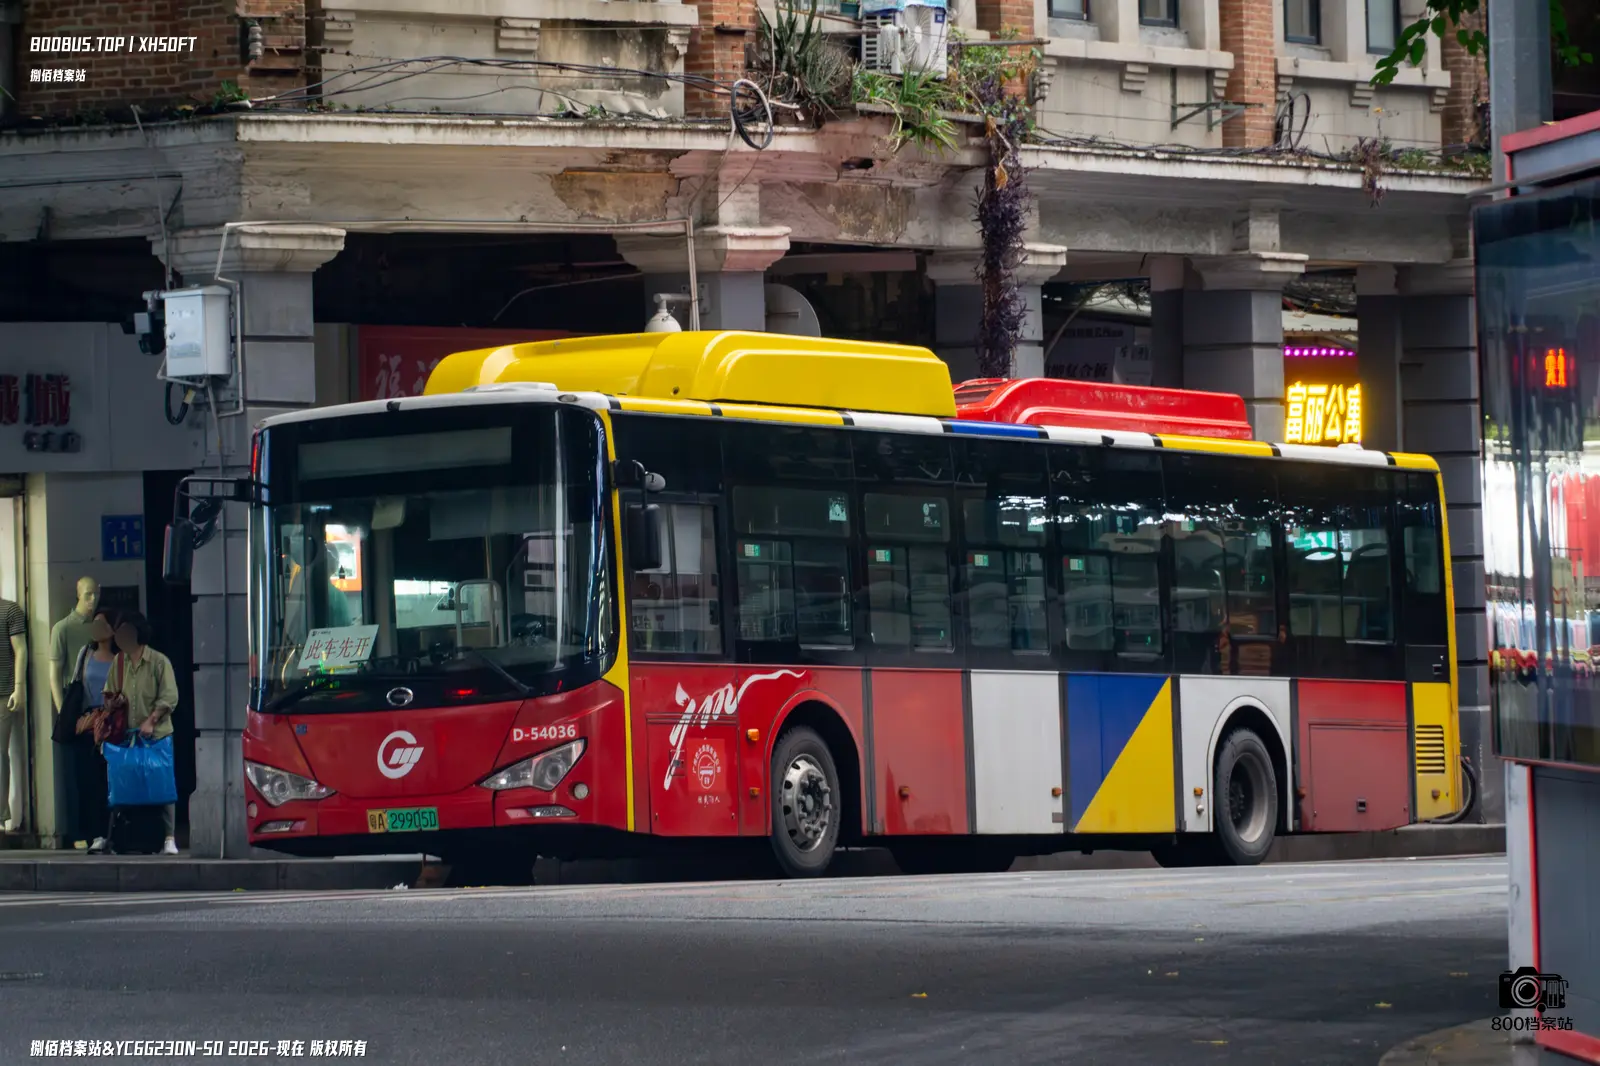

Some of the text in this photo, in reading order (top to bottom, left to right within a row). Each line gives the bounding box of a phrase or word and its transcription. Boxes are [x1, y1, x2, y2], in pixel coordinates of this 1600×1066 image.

[1284, 381, 1362, 443] 富丽公寓
[304, 636, 371, 660] 此车先开
[513, 724, 576, 741] D-54036
